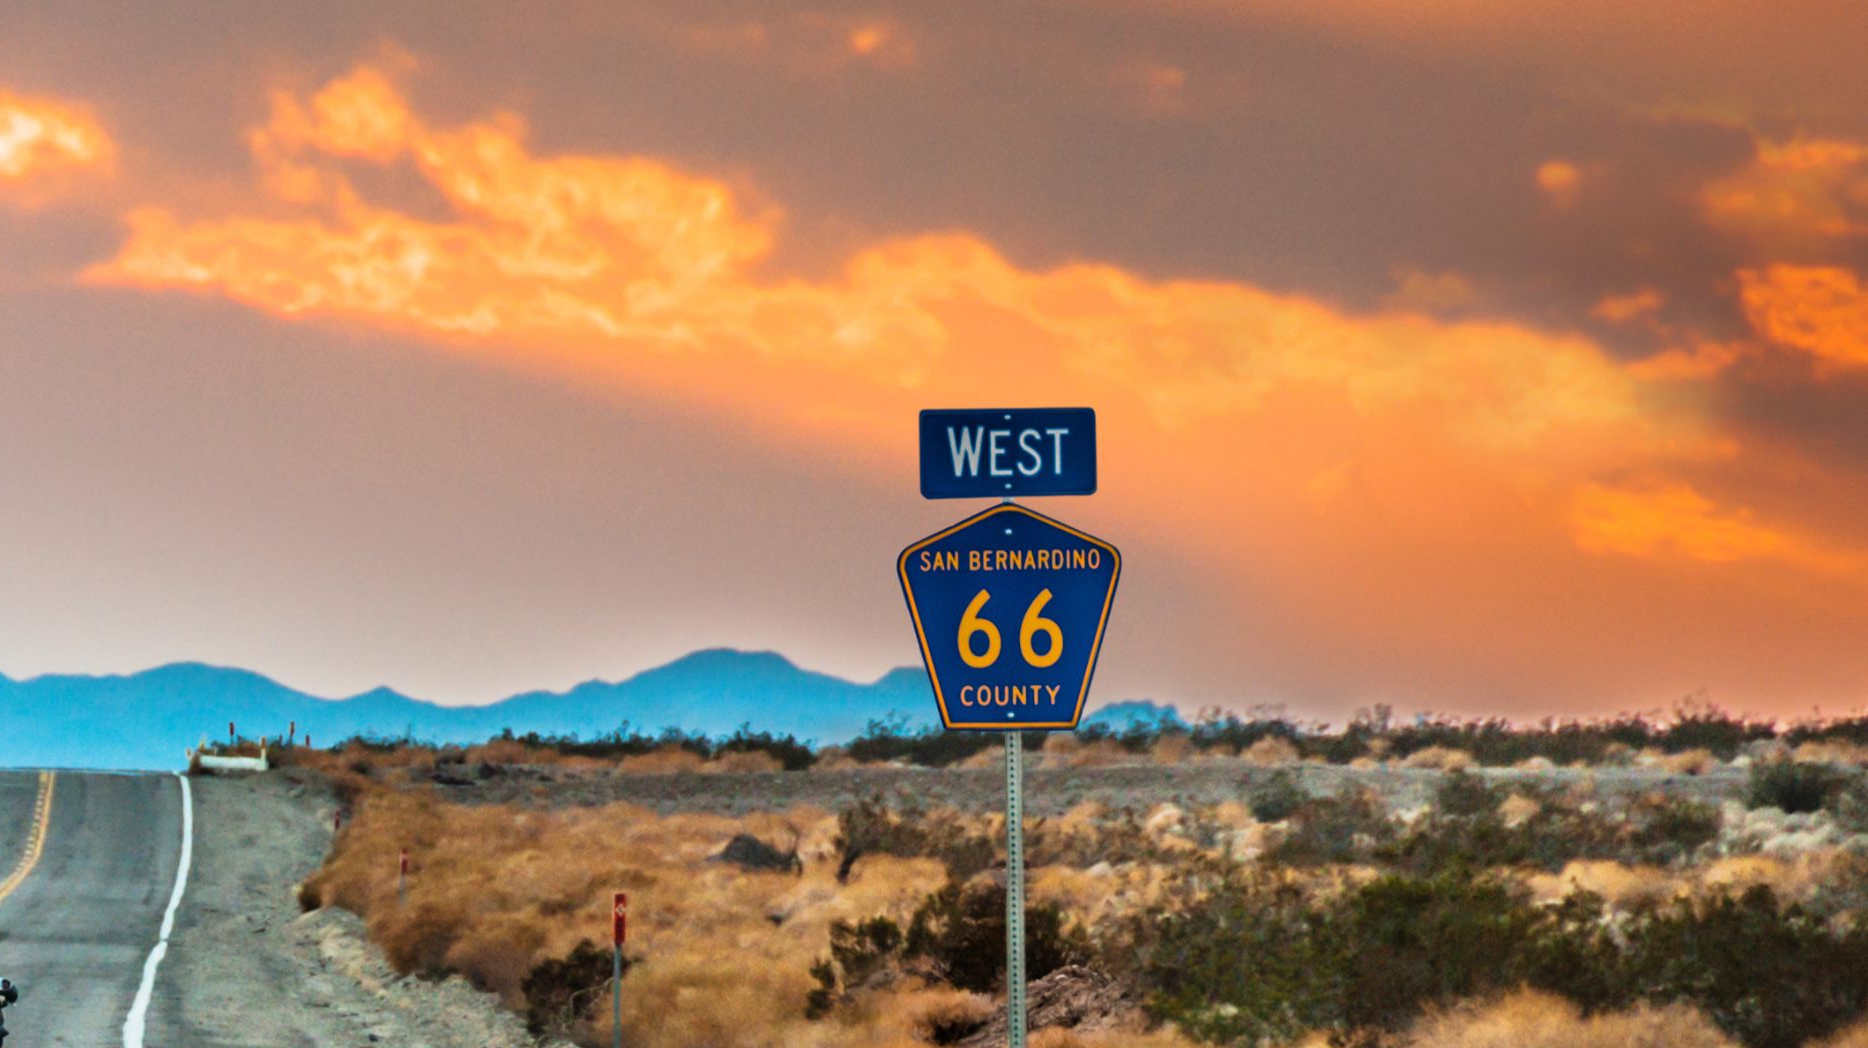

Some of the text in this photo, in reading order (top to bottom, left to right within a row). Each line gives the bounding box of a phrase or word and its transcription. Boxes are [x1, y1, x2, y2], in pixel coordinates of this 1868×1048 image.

[947, 426, 1069, 477] WEST
[919, 548, 1101, 572] SAN BERNARDINO
[957, 588, 1064, 669] 66
[959, 685, 1061, 706] COUNTY
